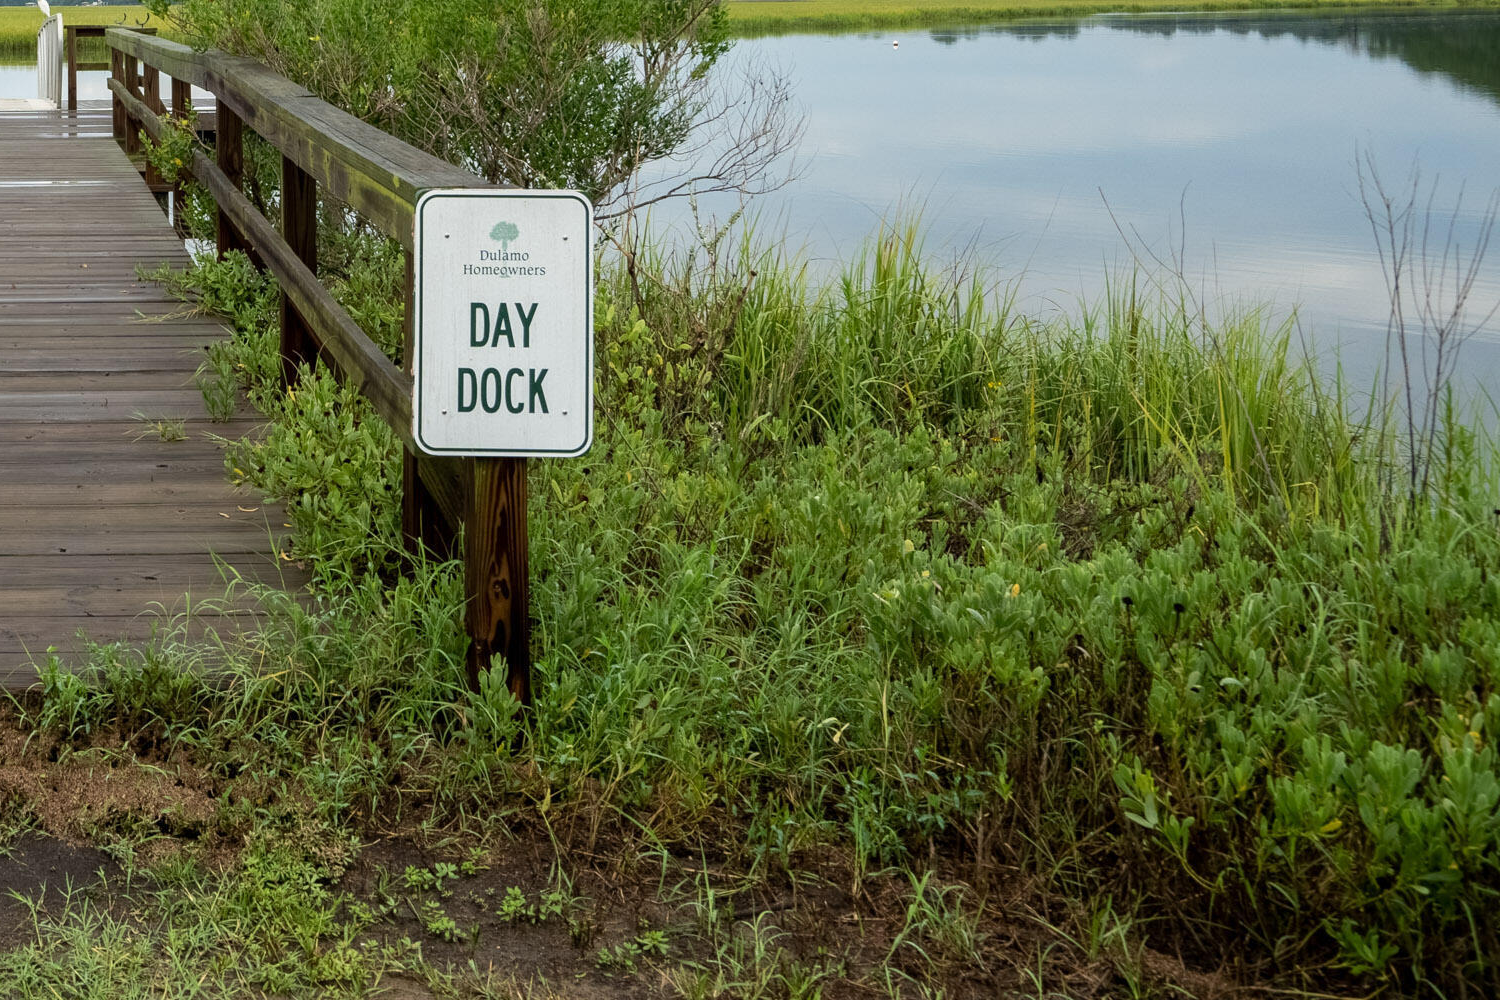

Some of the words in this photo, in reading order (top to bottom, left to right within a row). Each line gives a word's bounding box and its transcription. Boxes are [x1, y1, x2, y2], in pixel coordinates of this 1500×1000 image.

[480, 250, 529, 261] Dulamo
[463, 264, 546, 276] Homeowners
[470, 303, 539, 348] DAY
[457, 368, 549, 414] DOCK
